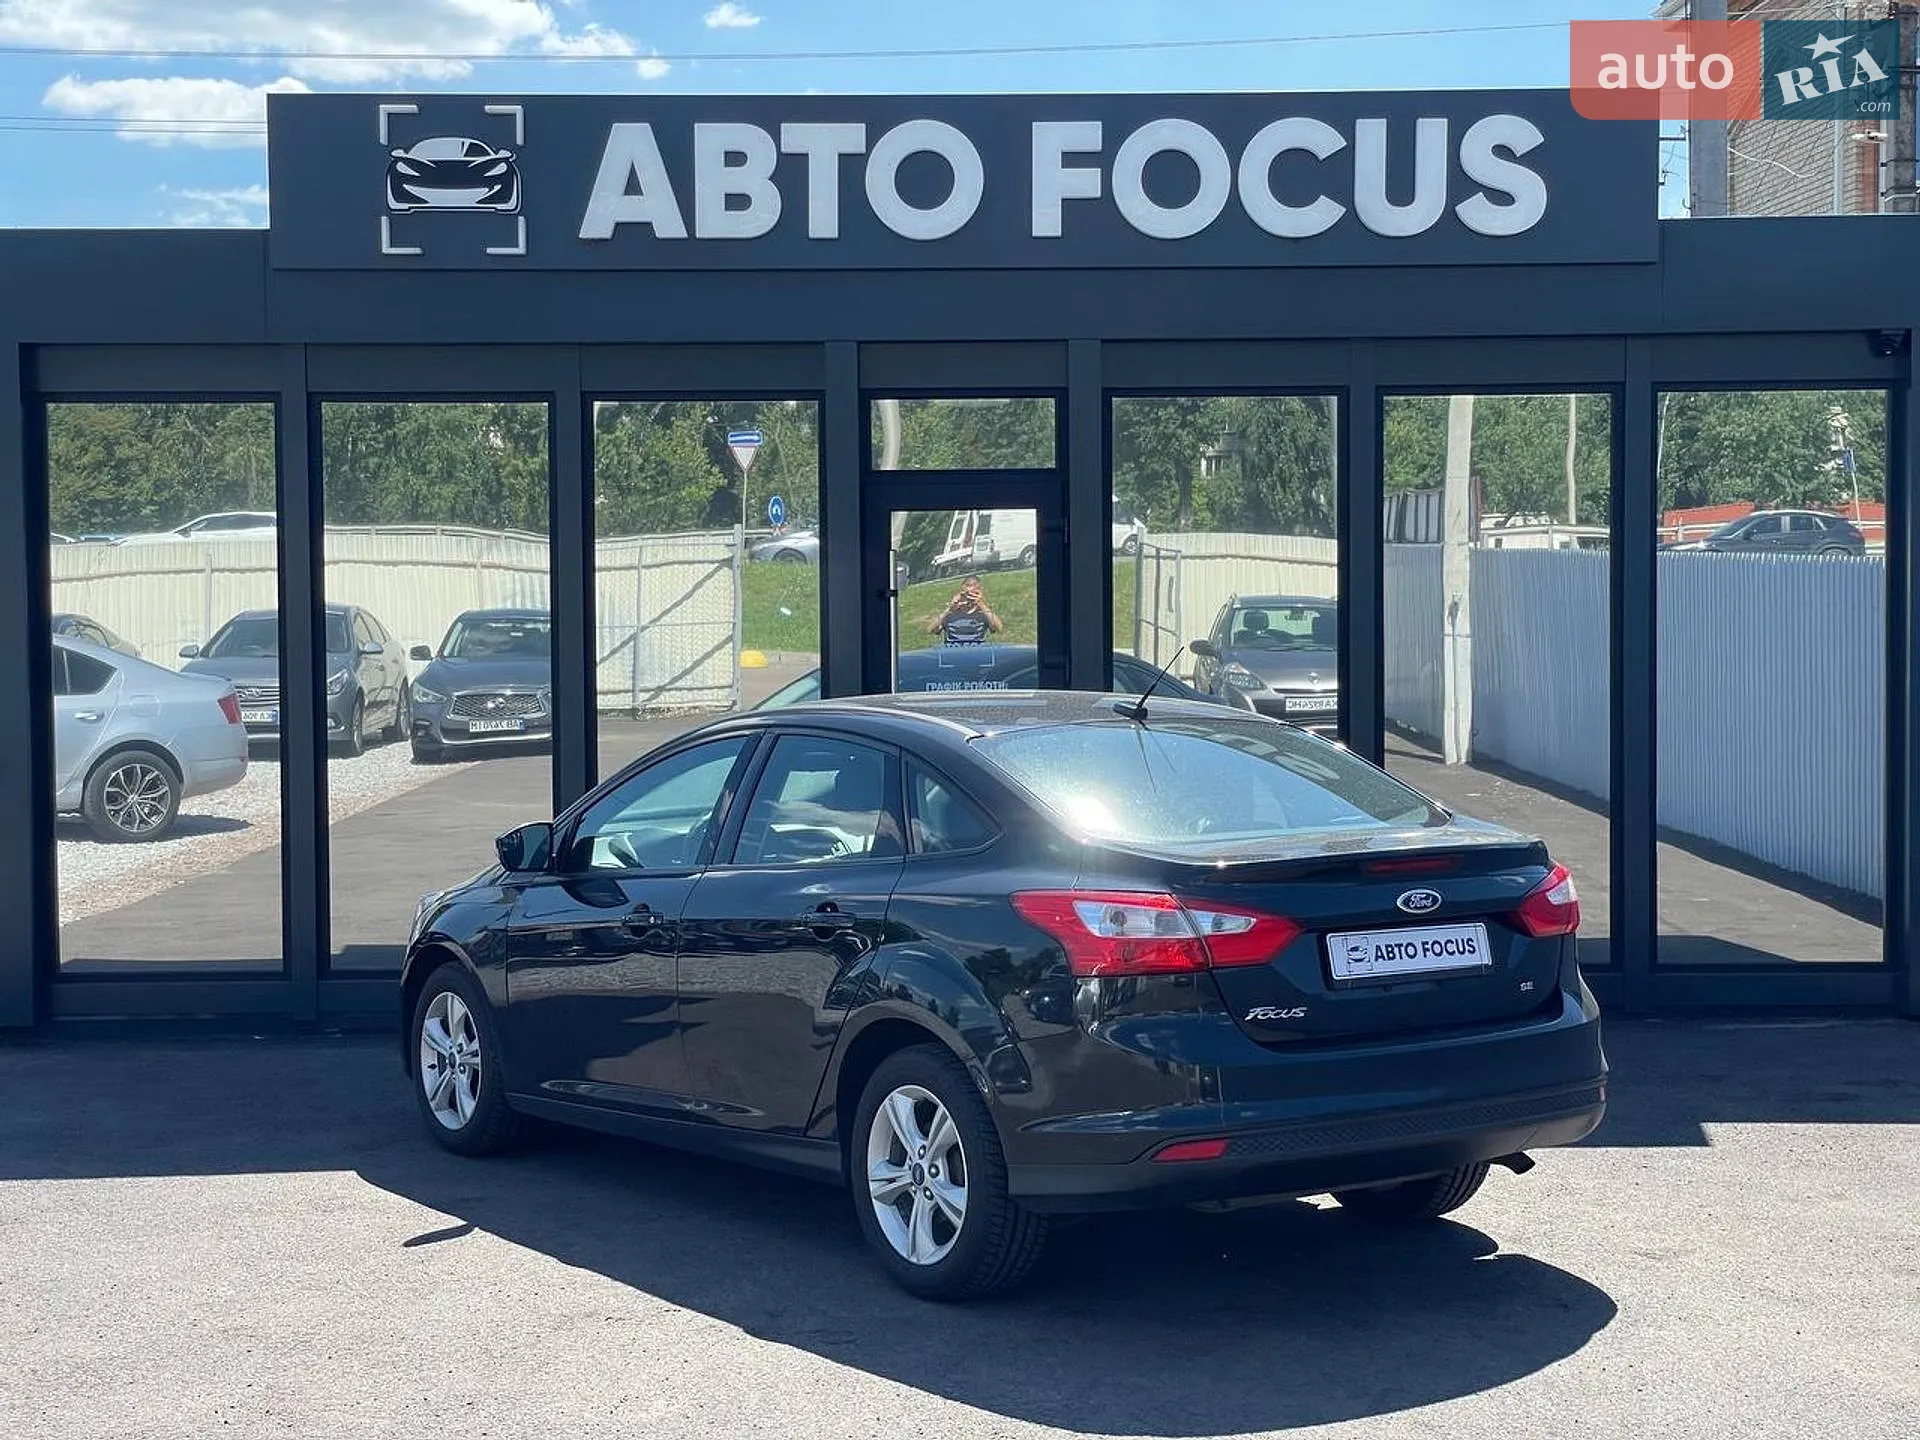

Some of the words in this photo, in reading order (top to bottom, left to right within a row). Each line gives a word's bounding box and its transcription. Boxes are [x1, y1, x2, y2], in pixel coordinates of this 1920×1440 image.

[578, 119, 984, 240] АВТО
[1032, 114, 1548, 240] FOCUS
[1374, 943, 1418, 962] АВТО
[1422, 938, 1477, 958] FOCUS
